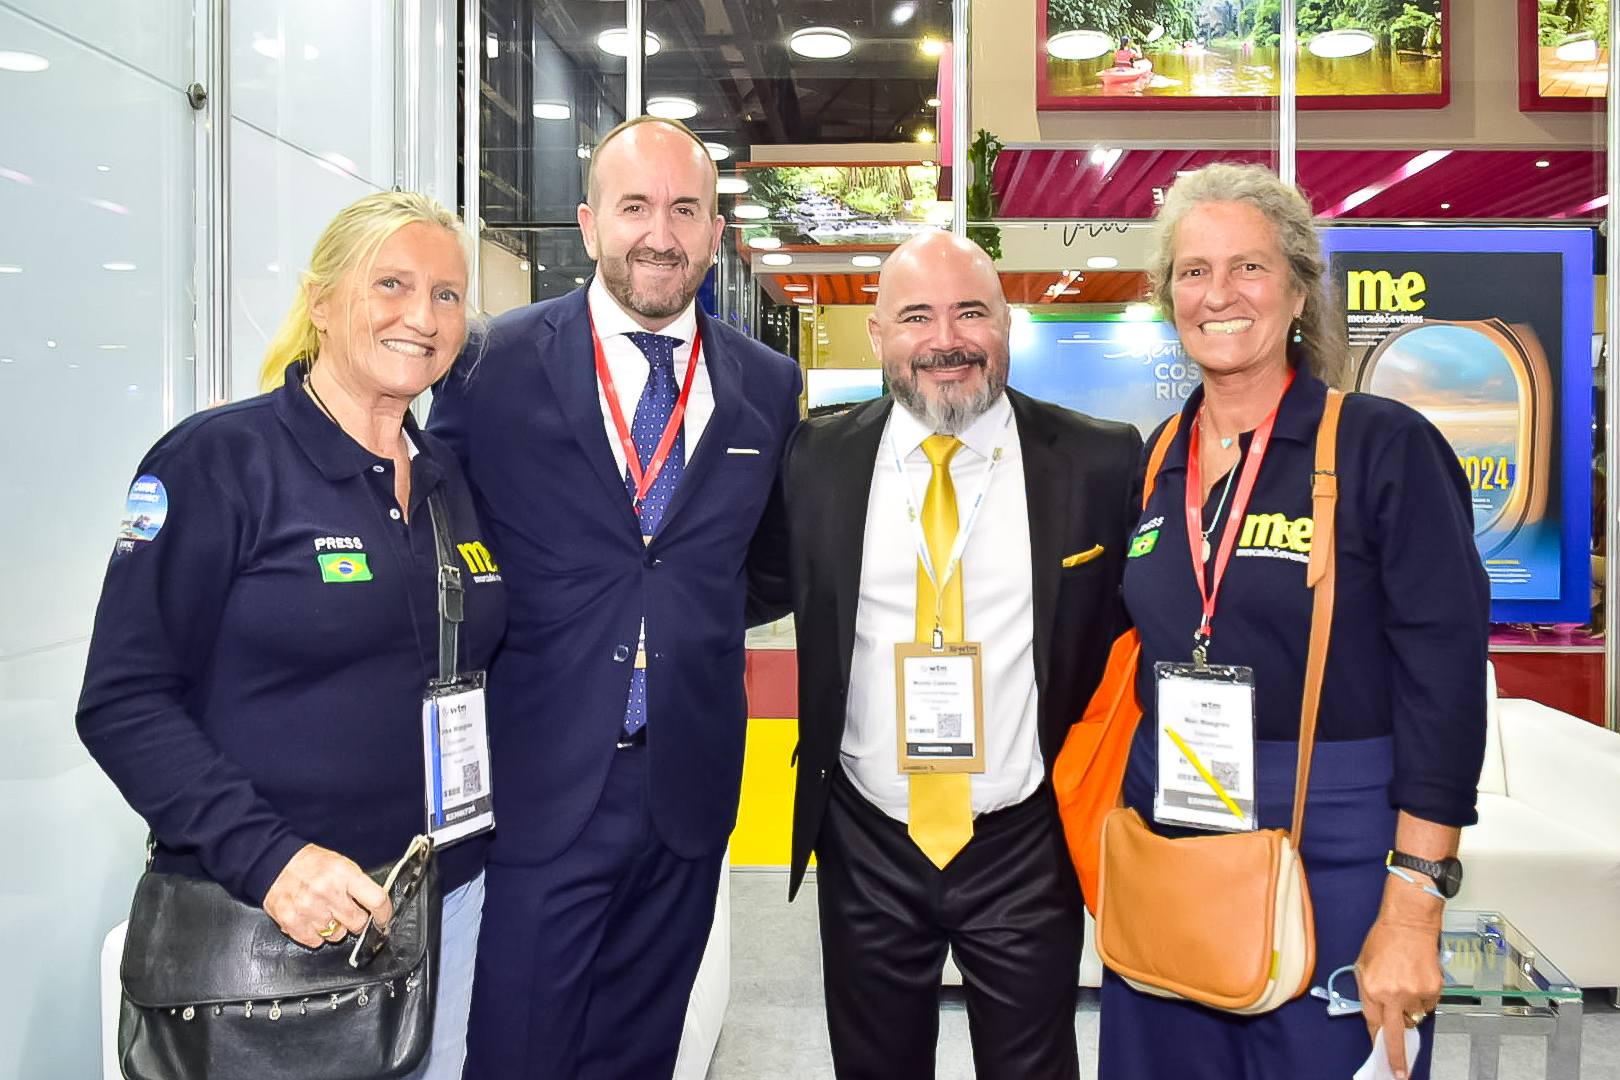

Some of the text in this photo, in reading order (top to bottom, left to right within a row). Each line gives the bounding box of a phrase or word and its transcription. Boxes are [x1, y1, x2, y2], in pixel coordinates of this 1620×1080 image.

[1347, 270, 1427, 312] m&e
[1347, 313, 1424, 324] mercado&eventos
[313, 535, 364, 552] PRESS
